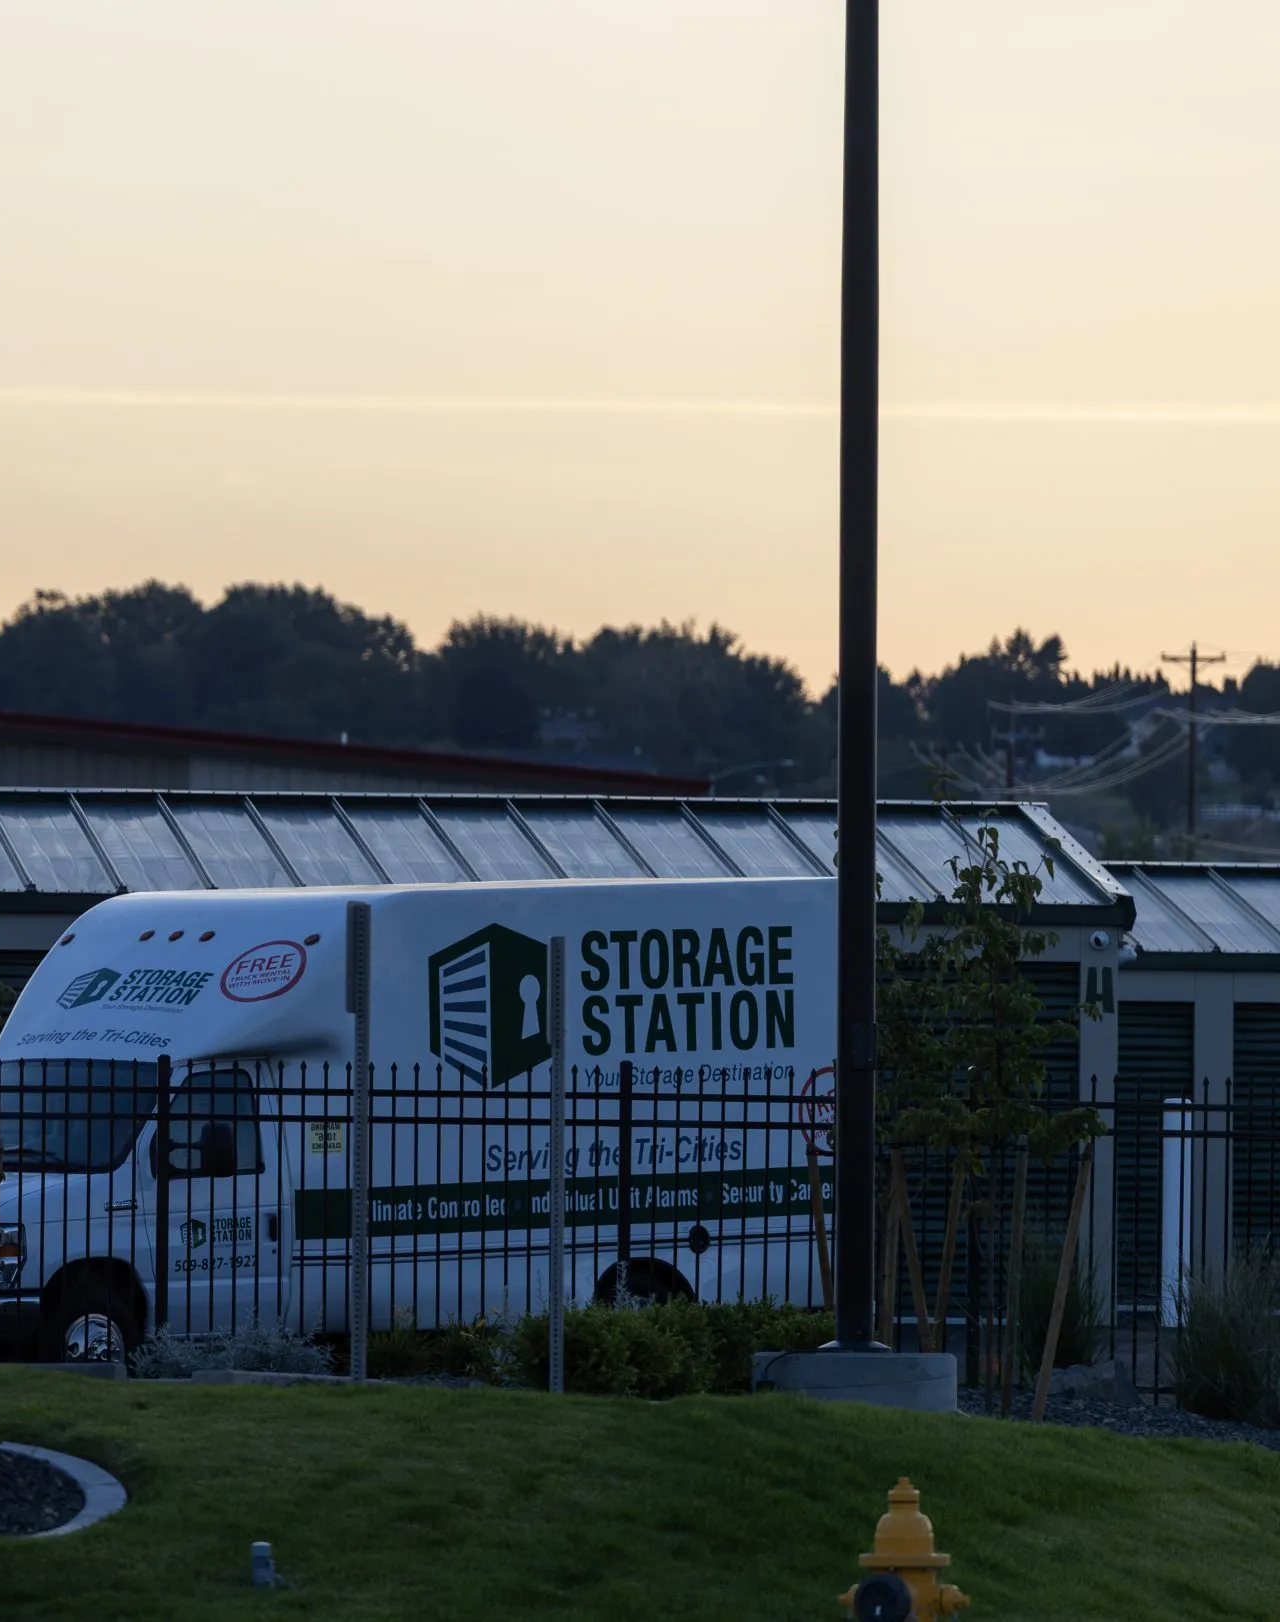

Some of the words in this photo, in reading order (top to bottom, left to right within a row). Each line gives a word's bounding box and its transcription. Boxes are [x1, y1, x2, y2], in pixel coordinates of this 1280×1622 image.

[236, 953, 296, 975] FREE
[581, 926, 794, 991] STORAGE
[123, 969, 214, 989] STORAGE
[229, 980, 250, 989] WITH
[252, 975, 290, 985] MOVE-IN
[231, 974, 257, 983] TRUCK
[260, 969, 290, 979] RENTAL
[108, 985, 201, 1006] STATION
[582, 990, 795, 1056] STATION
[17, 1030, 71, 1046] Serving
[72, 1028, 108, 1042] the
[100, 1029, 171, 1048] Tri-Cities
[486, 1142, 580, 1175] Servig
[588, 1139, 620, 1168] the
[635, 1135, 743, 1165] Tri-Cities
[372, 1199, 423, 1223] limate
[427, 1194, 508, 1220] Conrole
[608, 1185, 640, 1210] Uit
[721, 1180, 784, 1205] Securty
[211, 1229, 252, 1242] TATON
